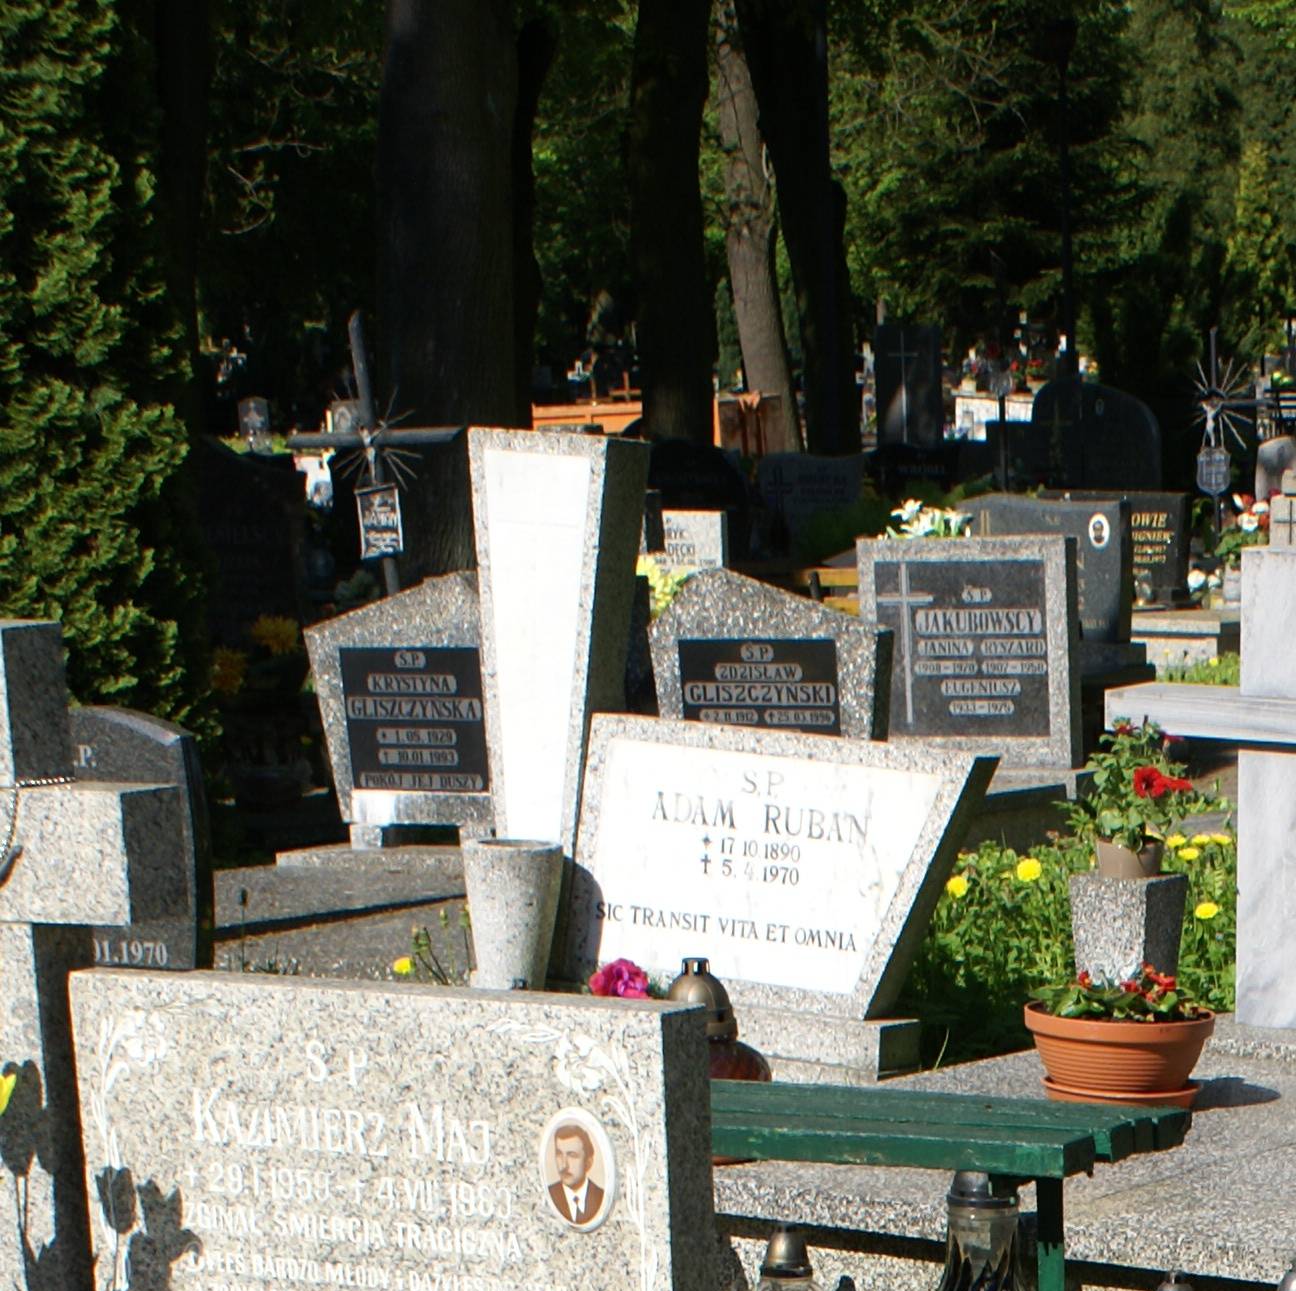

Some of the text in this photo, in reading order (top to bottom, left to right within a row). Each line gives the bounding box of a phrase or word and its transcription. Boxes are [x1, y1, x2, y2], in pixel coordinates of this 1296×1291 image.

[1131, 512, 1168, 527] OWIE
[667, 543, 696, 557] DECKI
[918, 610, 1037, 633] JAKUBOWSCY
[924, 640, 1044, 656] JANINA RYSZARD
[372, 675, 451, 692] KRYSTYNA
[689, 682, 831, 704] GLISZCZYŃSKI
[944, 680, 1018, 694] EUGENIUSZ
[351, 697, 478, 719] GLISZCZYŃSKA
[364, 771, 404, 787] POKÓJ
[440, 774, 478, 789] DUSZY
[651, 791, 872, 845] ADAM RUBAN
[595, 901, 858, 952] SIC TRANSIT VITA ET OMNIA
[192, 1087, 491, 1165] KAZIMIERZ MAJ
[253, 1255, 318, 1281] BARDZO
[325, 1262, 389, 1289] MŁODY
